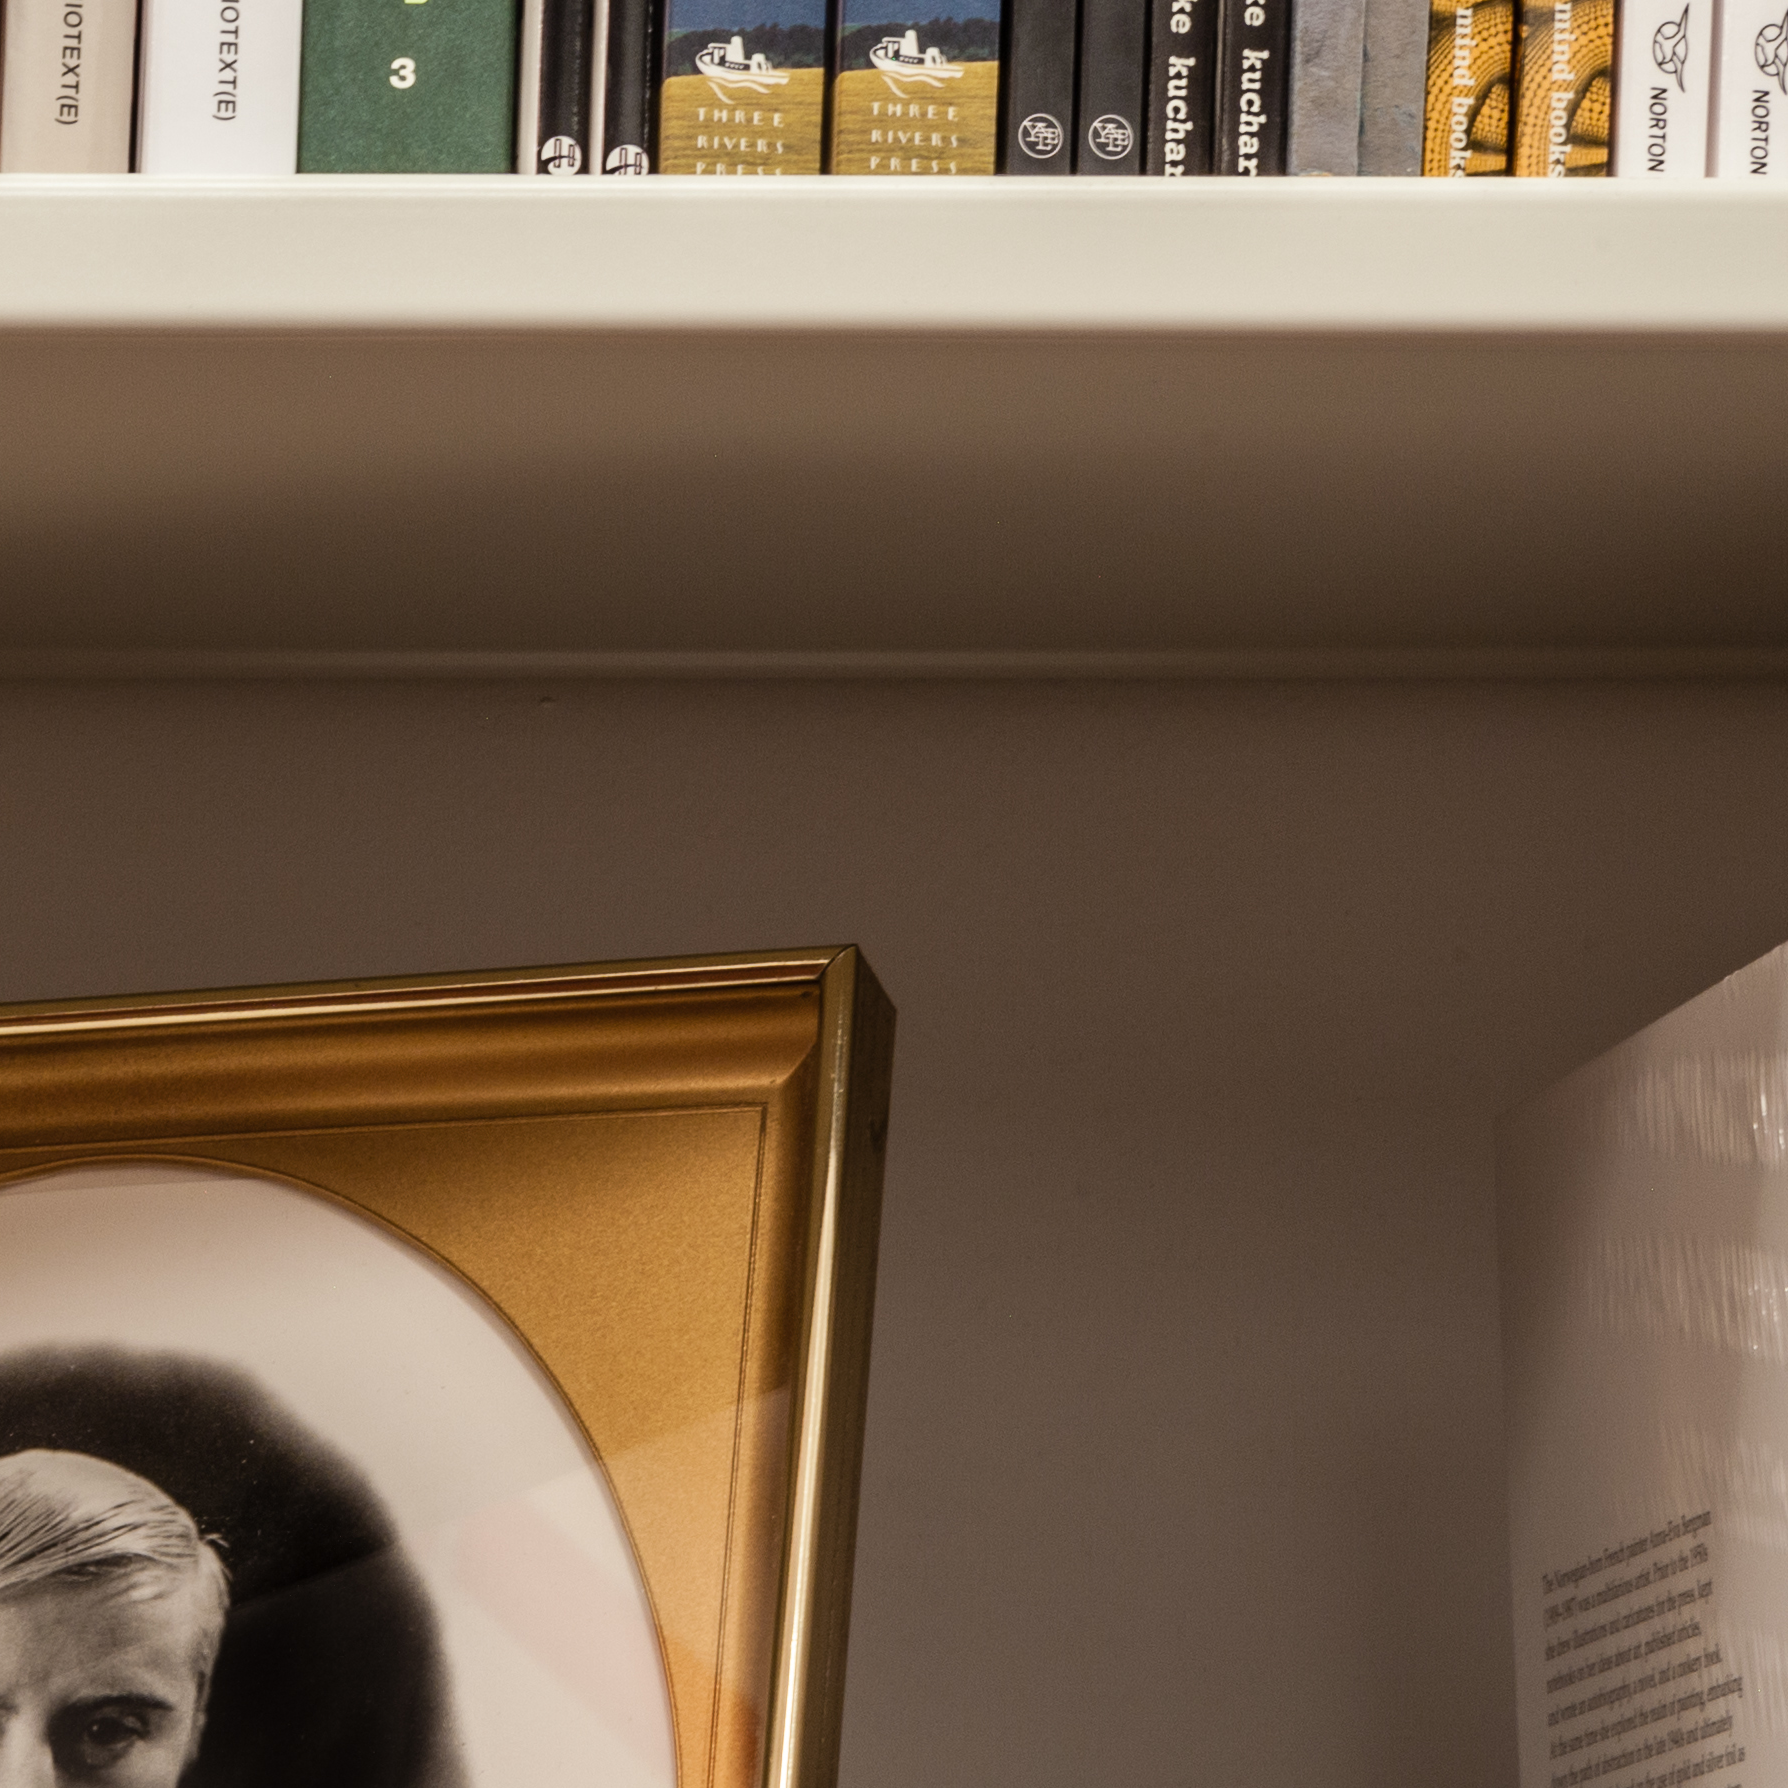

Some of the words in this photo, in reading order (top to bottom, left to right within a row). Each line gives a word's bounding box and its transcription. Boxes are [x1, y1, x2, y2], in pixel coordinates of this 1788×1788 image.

[1452, 7, 1477, 88] mind
[1551, 2, 1577, 82] mind
[388, 57, 417, 89] 3
[697, 107, 785, 128] THREE
[870, 101, 959, 122] THREE
[870, 129, 959, 148] RIVERS
[1238, 47, 1270, 177] kuchar
[1547, 91, 1575, 177] books
[1647, 86, 1668, 173] NORTON
[1749, 89, 1771, 176] NORTON
[696, 135, 784, 155] RIVERS
[869, 156, 958, 175] PRESS
